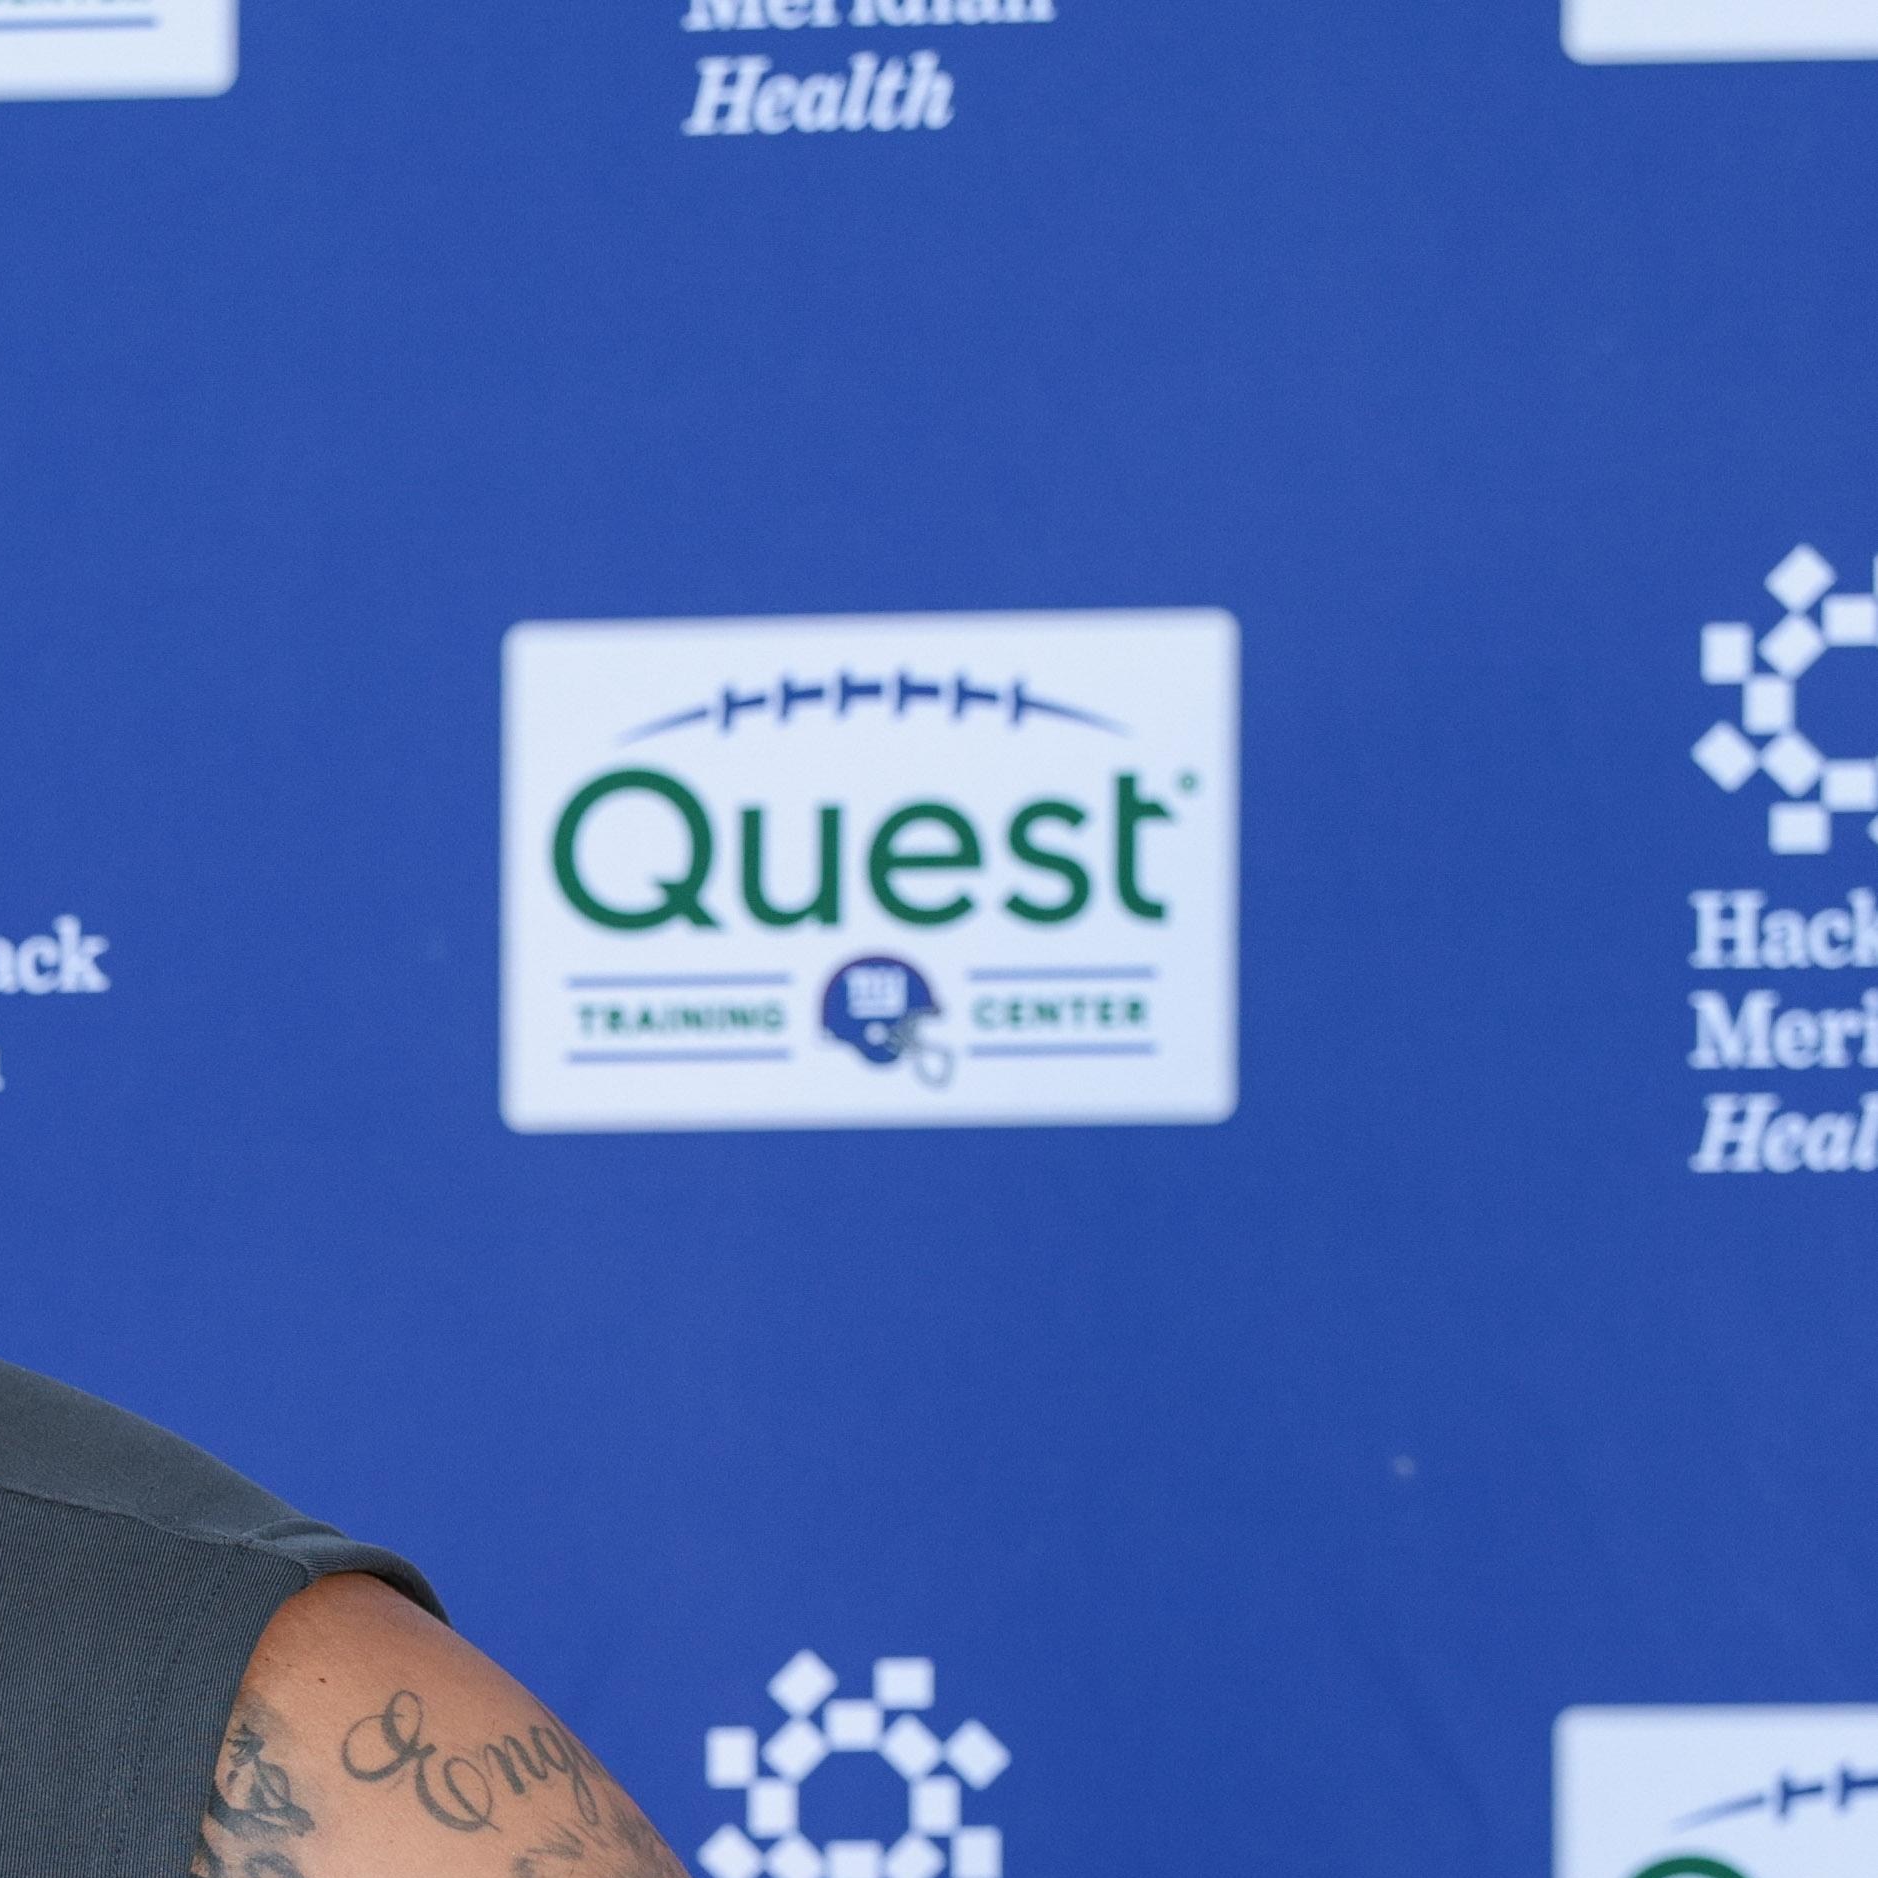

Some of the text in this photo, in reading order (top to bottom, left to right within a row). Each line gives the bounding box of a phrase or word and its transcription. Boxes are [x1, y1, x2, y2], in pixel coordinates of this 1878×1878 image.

[682, 50, 954, 136] Health
[550, 766, 1172, 934] Quest
[579, 995, 1149, 1036] TRAINING CENTER
